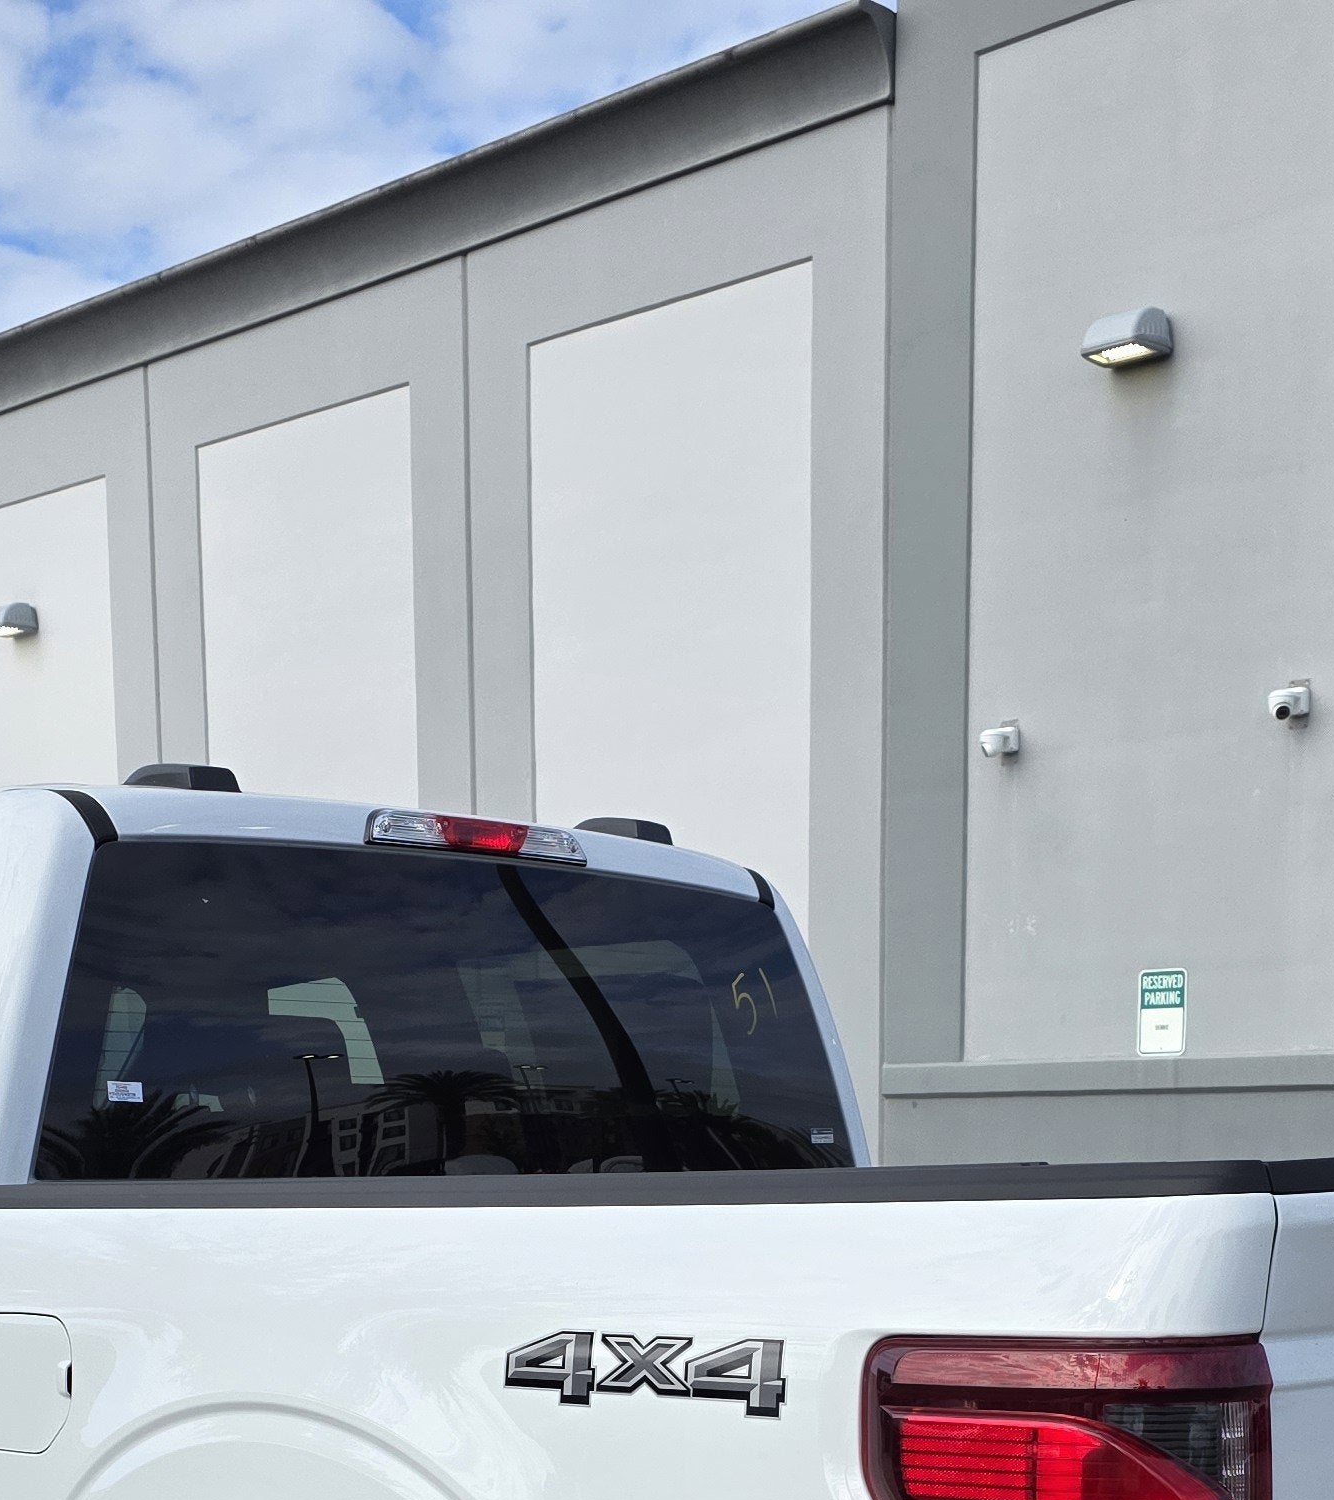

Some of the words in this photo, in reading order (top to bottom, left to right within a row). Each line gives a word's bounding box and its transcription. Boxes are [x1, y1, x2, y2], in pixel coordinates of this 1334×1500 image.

[1142, 973, 1184, 990] RESERVED
[731, 966, 779, 1036] 51
[1143, 990, 1181, 1006] PARKING
